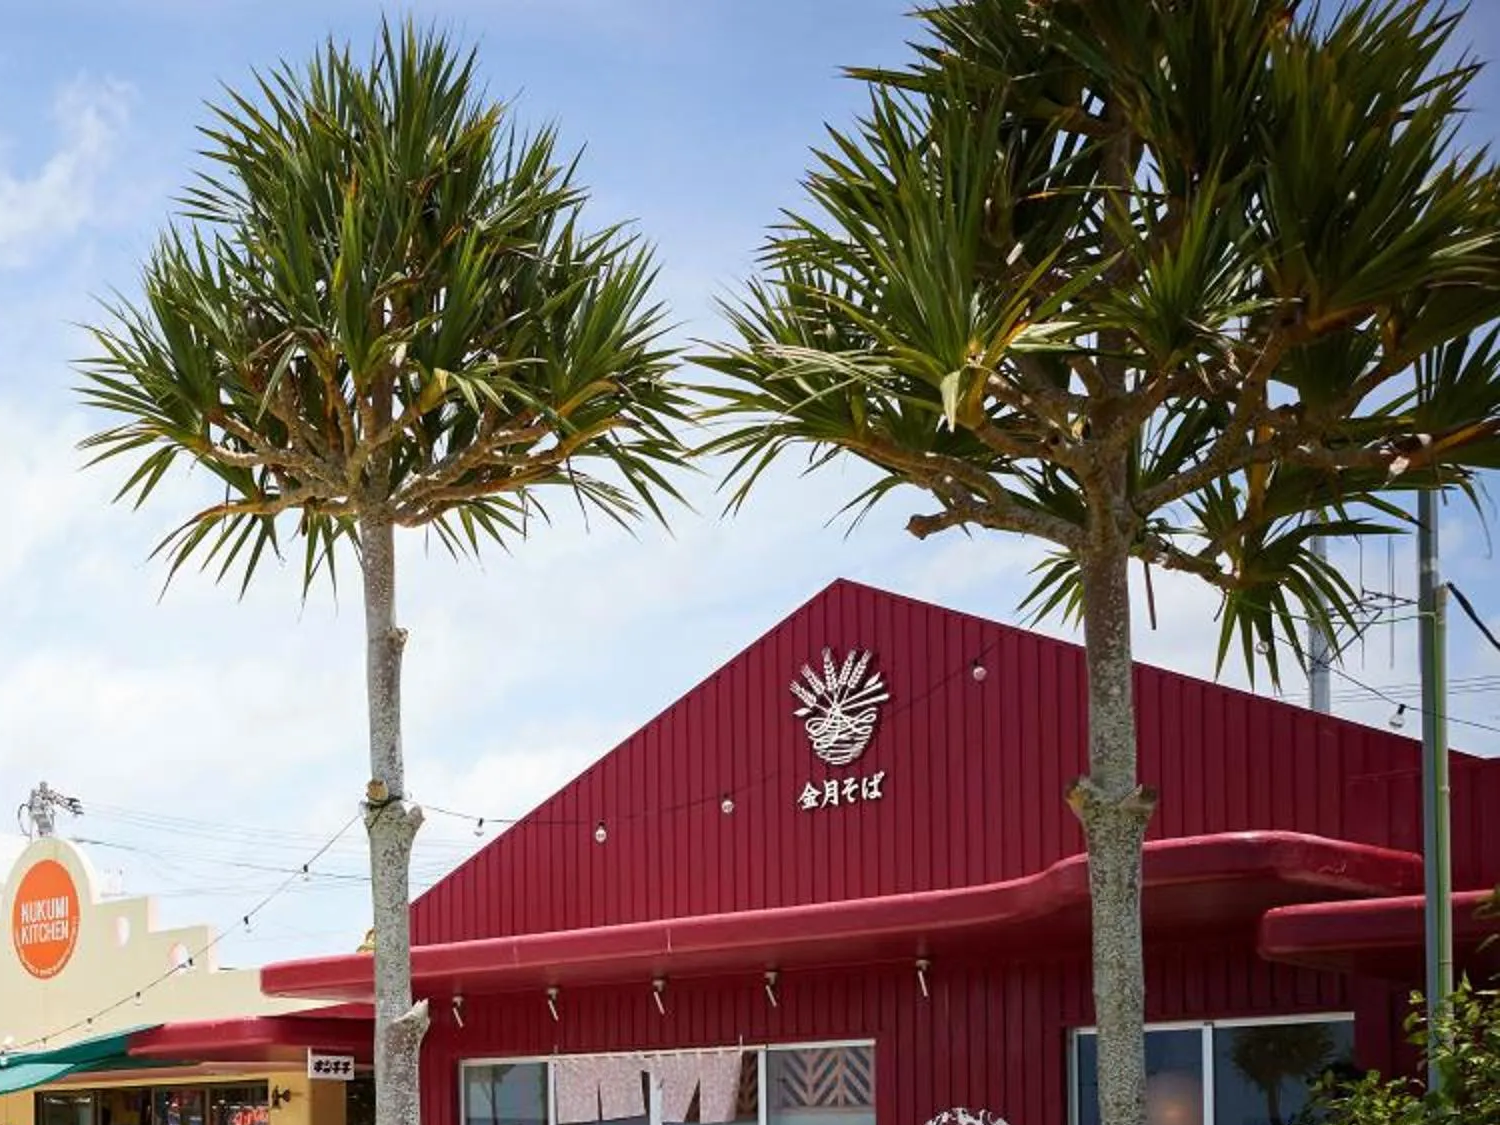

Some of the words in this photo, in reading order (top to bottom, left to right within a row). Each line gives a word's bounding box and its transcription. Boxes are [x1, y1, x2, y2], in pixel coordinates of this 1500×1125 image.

[797, 771, 885, 810] 金月そば
[21, 895, 69, 924] NUKUMI
[21, 919, 69, 945] KITCHEN
